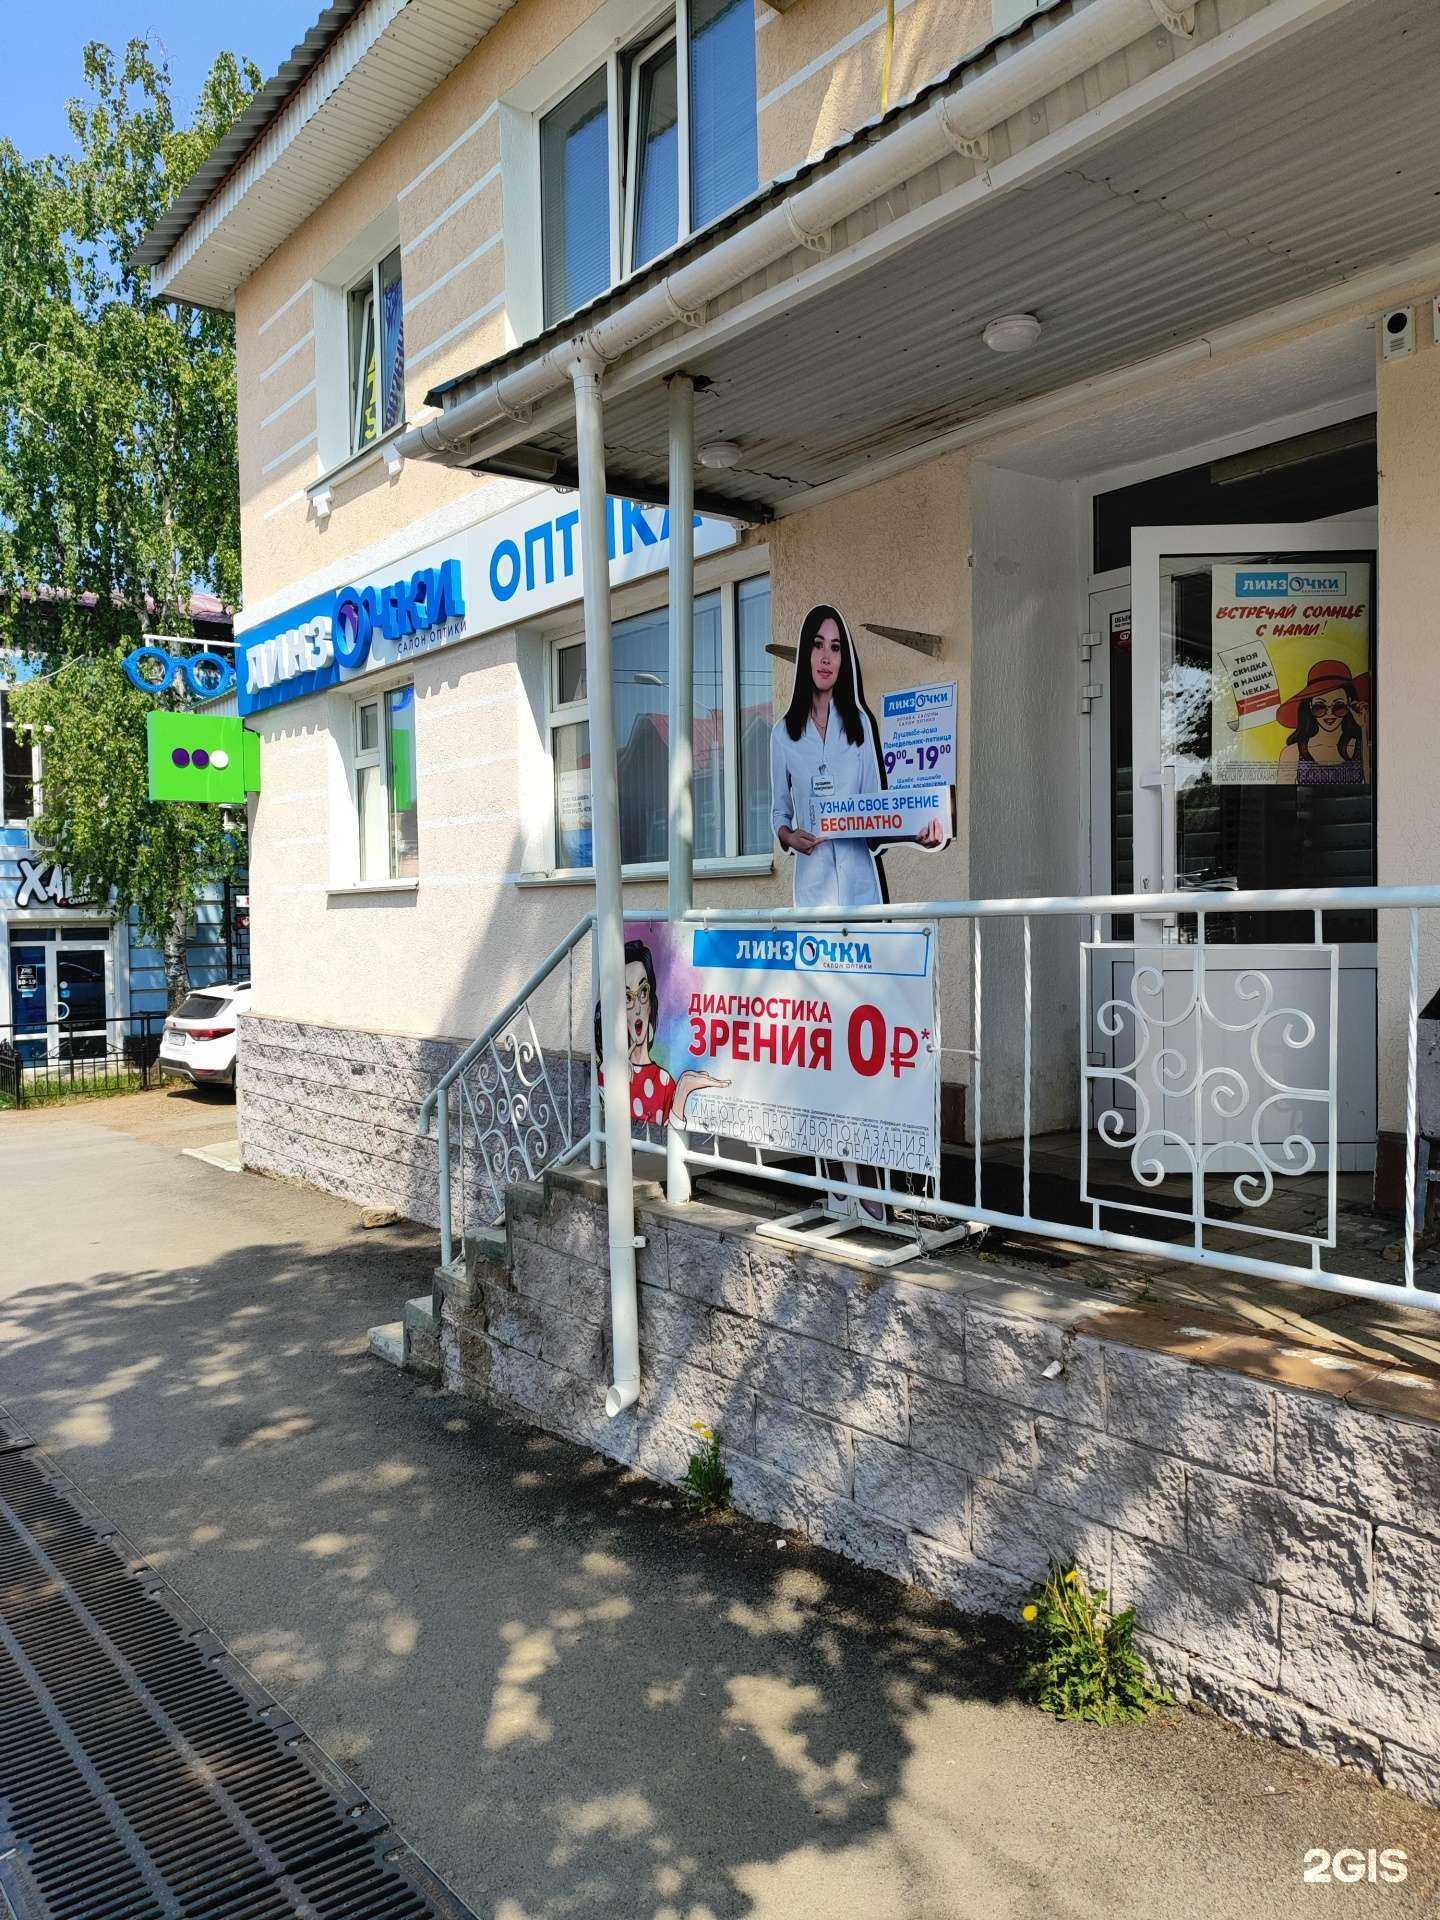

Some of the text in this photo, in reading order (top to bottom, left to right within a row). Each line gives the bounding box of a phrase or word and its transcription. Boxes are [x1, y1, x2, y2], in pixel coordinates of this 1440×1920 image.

[1241, 576, 1339, 593] ЛИНЗОЧКИ
[1216, 603, 1366, 620] ВСТРЕЧАЙ СОЛНЦЕ
[1255, 620, 1328, 637] С НАМИ!
[397, 621, 468, 655] САЛОН ОПТИКИ
[1234, 652, 1258, 665] ТВОЯ
[1232, 661, 1268, 677] СКИДКА
[1233, 670, 1274, 689] В НАШИХ
[1241, 683, 1271, 697] ЧЕКАХ
[888, 693, 948, 711] ЛИНЗОЧКИ
[819, 797, 855, 814] УЗНАЙ
[857, 797, 889, 812] СВОЕ
[892, 795, 940, 810] ЗРЕНИЕ
[820, 814, 903, 832] БЕСПЛАТНО
[736, 935, 872, 966] ЛИНЗОЧКИ
[822, 961, 844, 969] САЛОН
[688, 993, 833, 1024] ДИАГНОСТИКА
[688, 1017, 833, 1072] ЗРЕНИЯ
[691, 1101, 754, 1123] ИМЕЮТСЯ
[762, 1111, 927, 1154] ПРОТИВОПОКАЗАНИЯ
[836, 1140, 931, 1171] СПЕЦИАЛИСТА
